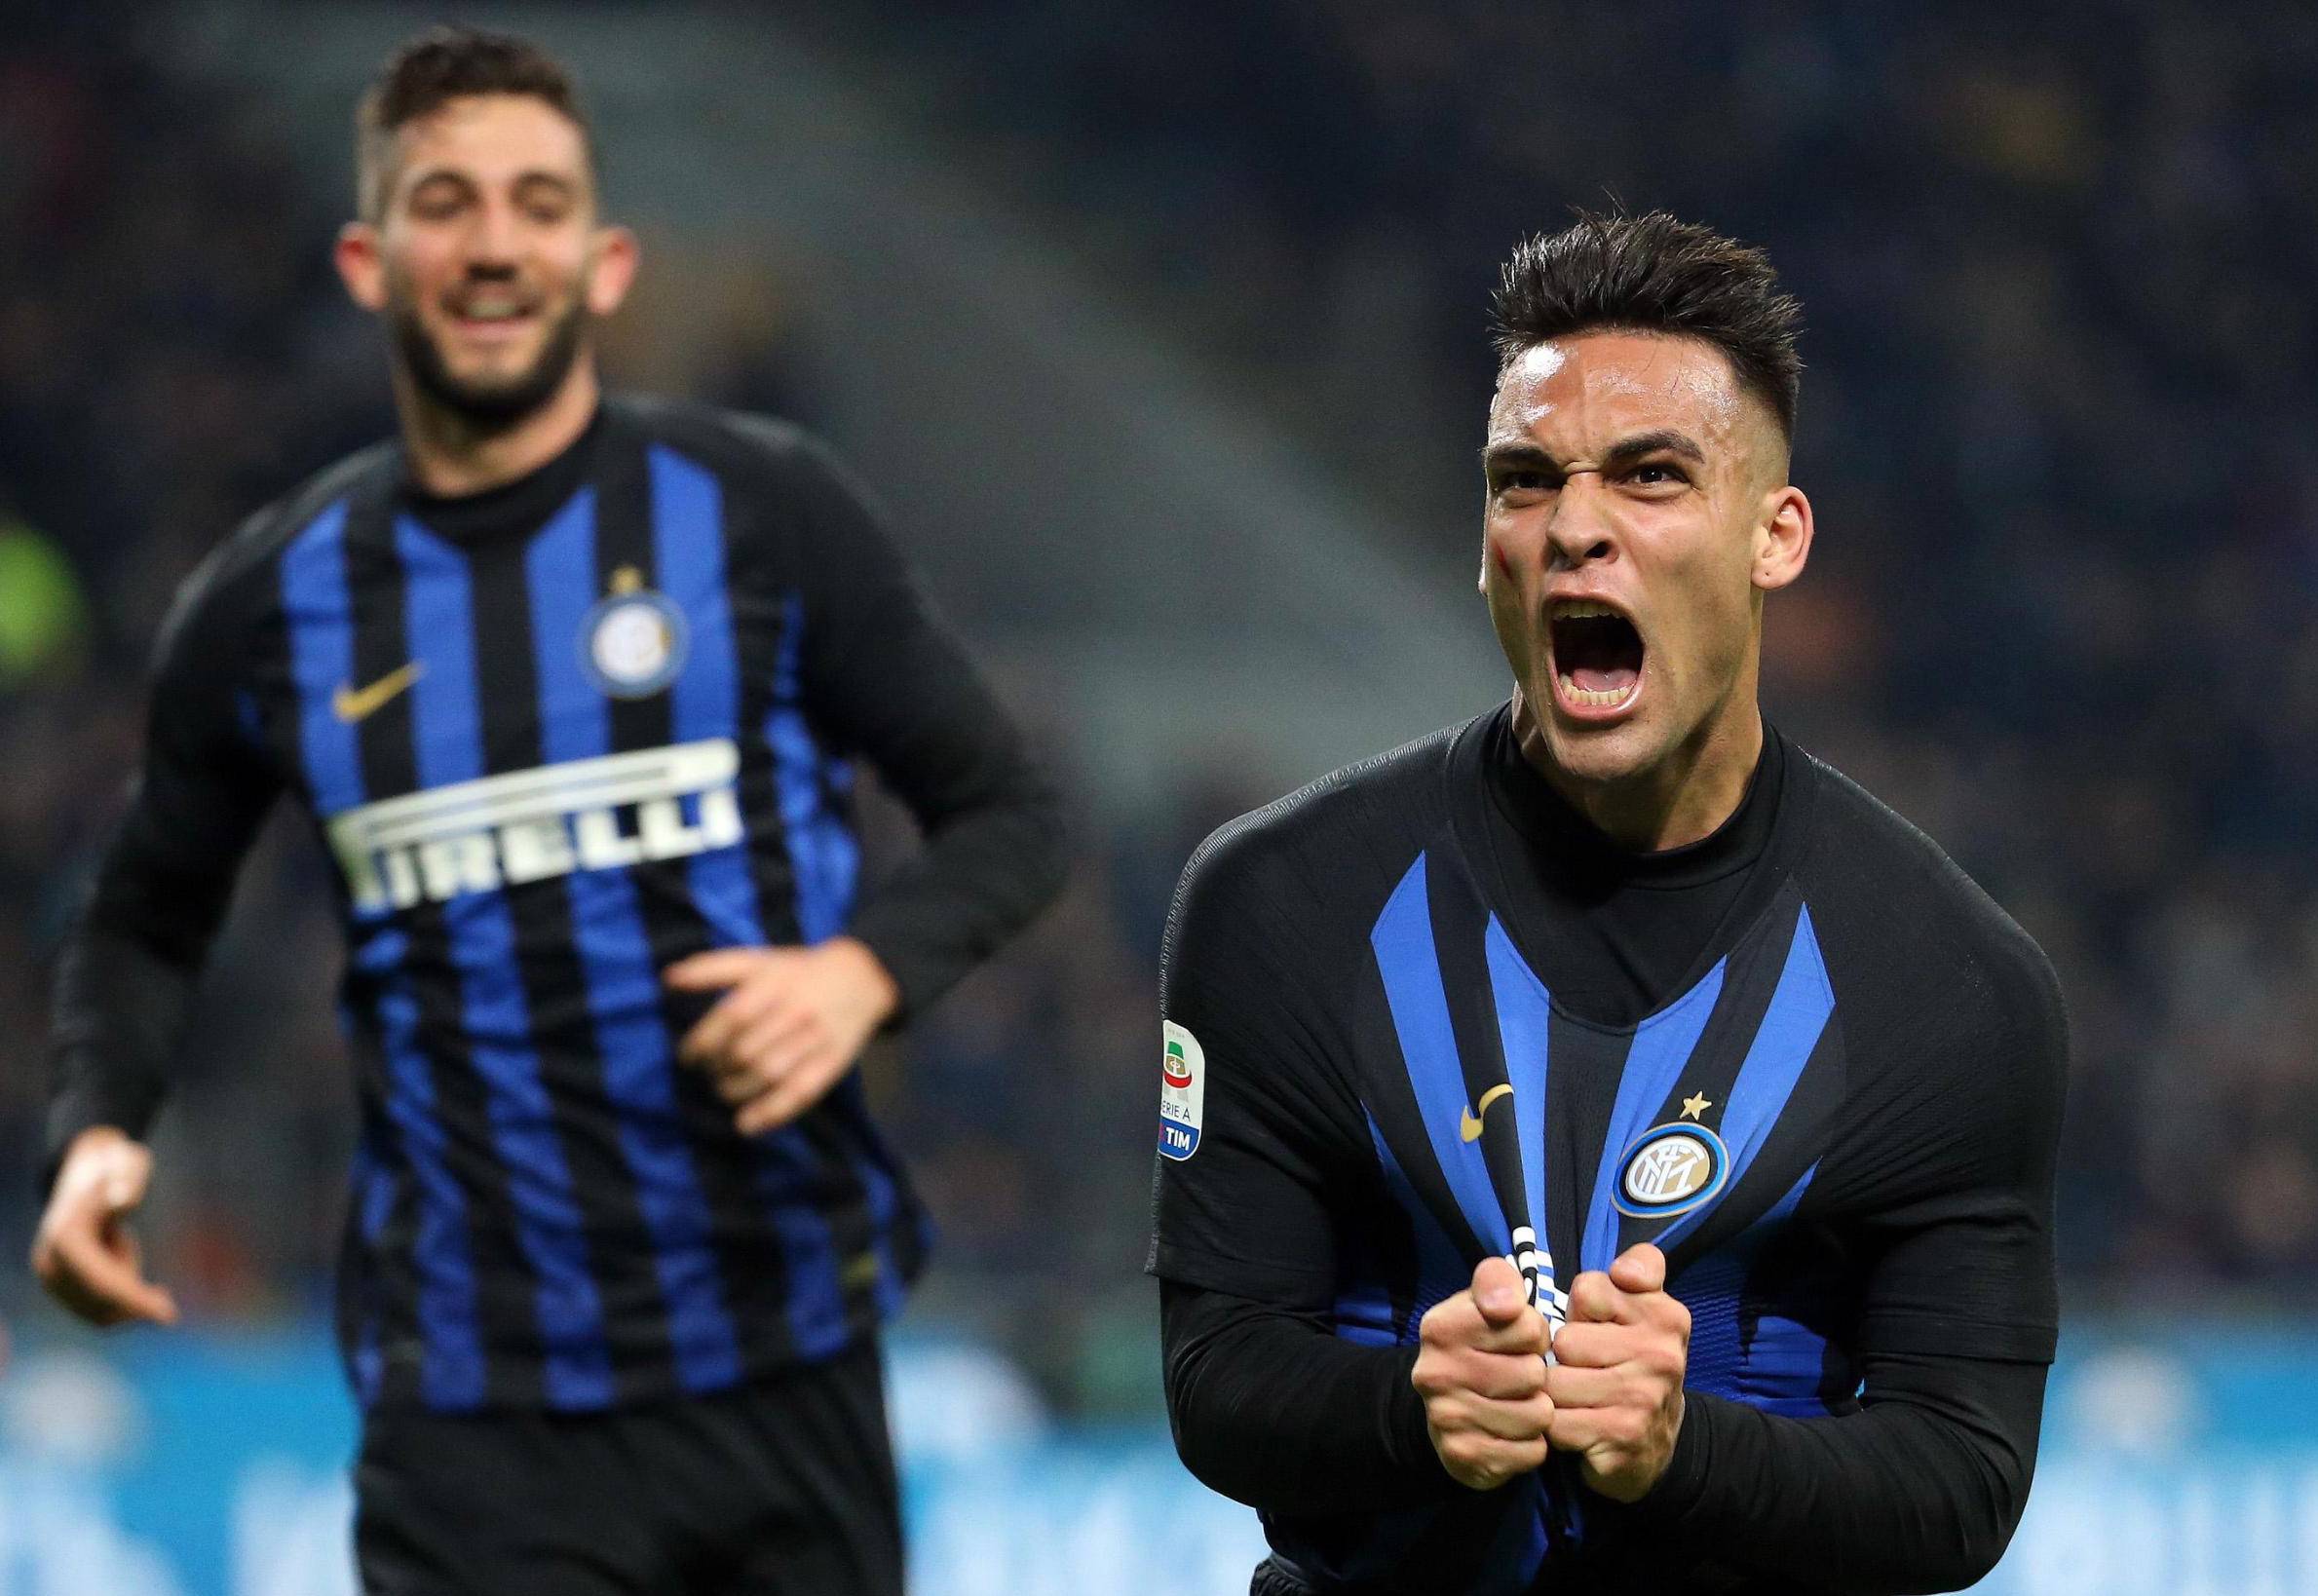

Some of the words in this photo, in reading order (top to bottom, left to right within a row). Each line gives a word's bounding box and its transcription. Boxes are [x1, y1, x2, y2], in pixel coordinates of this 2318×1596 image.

[327, 739, 742, 910] PIRELLI
[1162, 1100, 1180, 1118] ERIE
[1182, 1107, 1191, 1121] A
[1165, 1126, 1191, 1151] TIM
